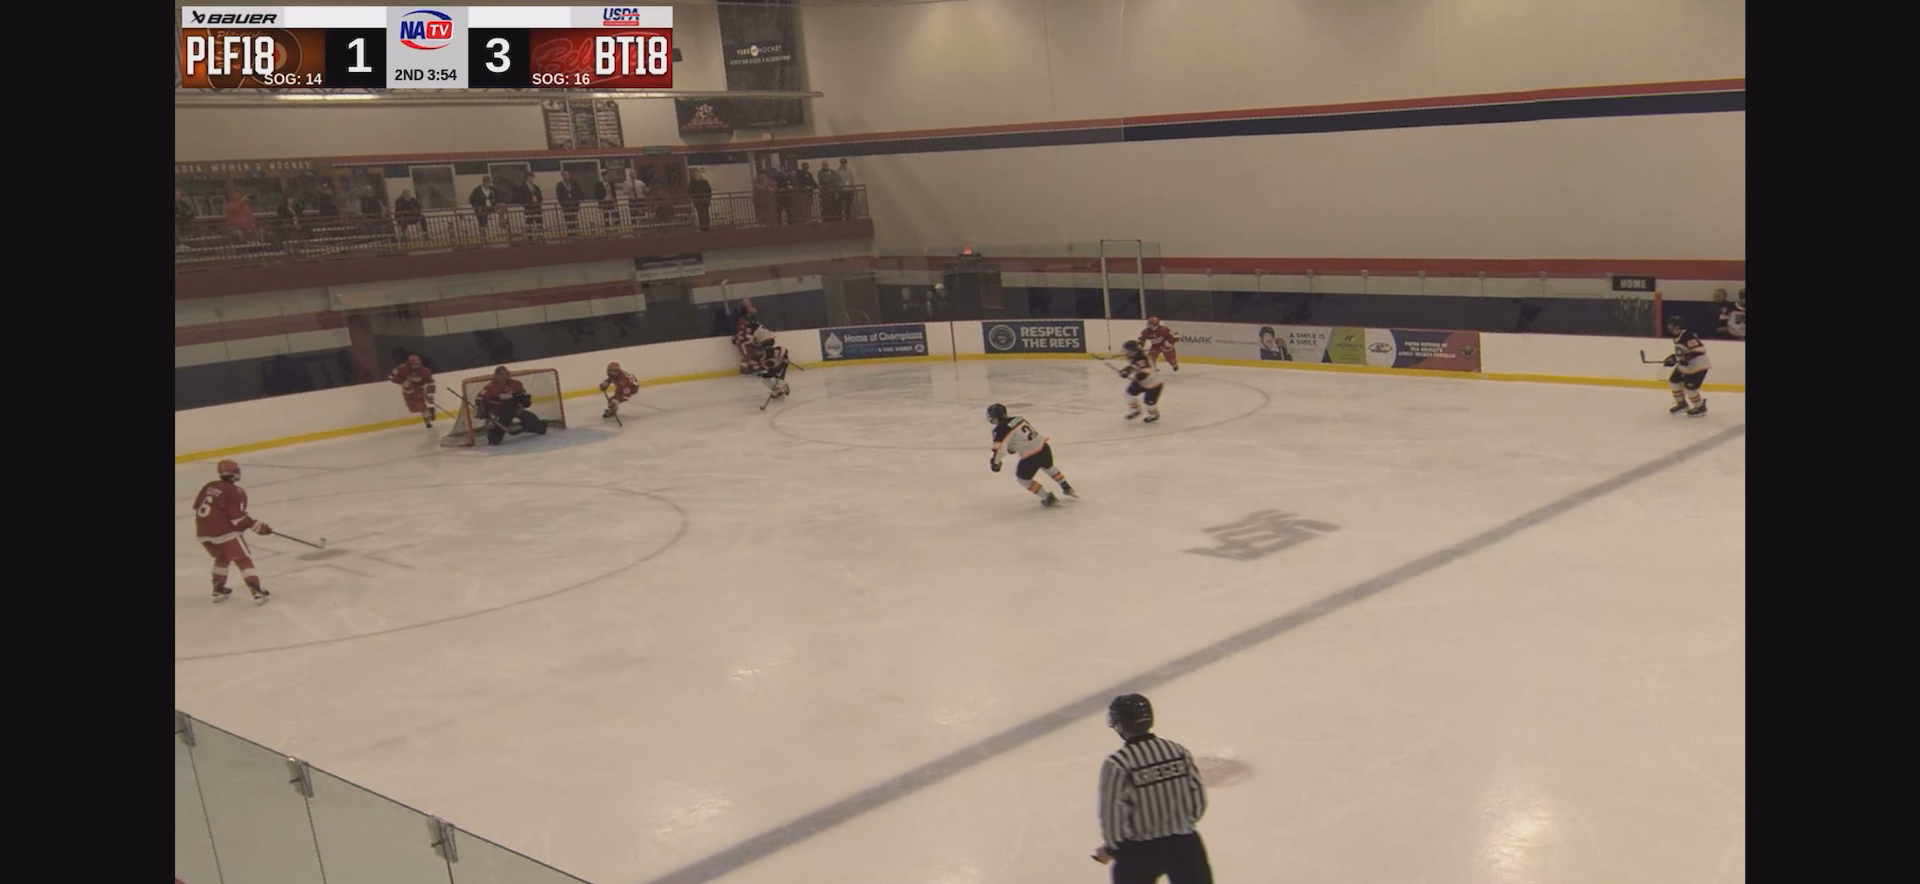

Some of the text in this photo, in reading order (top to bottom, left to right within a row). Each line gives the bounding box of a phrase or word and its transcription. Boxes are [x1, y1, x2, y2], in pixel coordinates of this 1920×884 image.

[1620, 278, 1647, 289] HOME
[843, 331, 923, 343] Home of Champions
[1020, 326, 1080, 337] RESPECT
[1295, 332, 1317, 340] SMILE
[1021, 338, 1080, 348] THE REFS
[197, 496, 214, 518] 6
